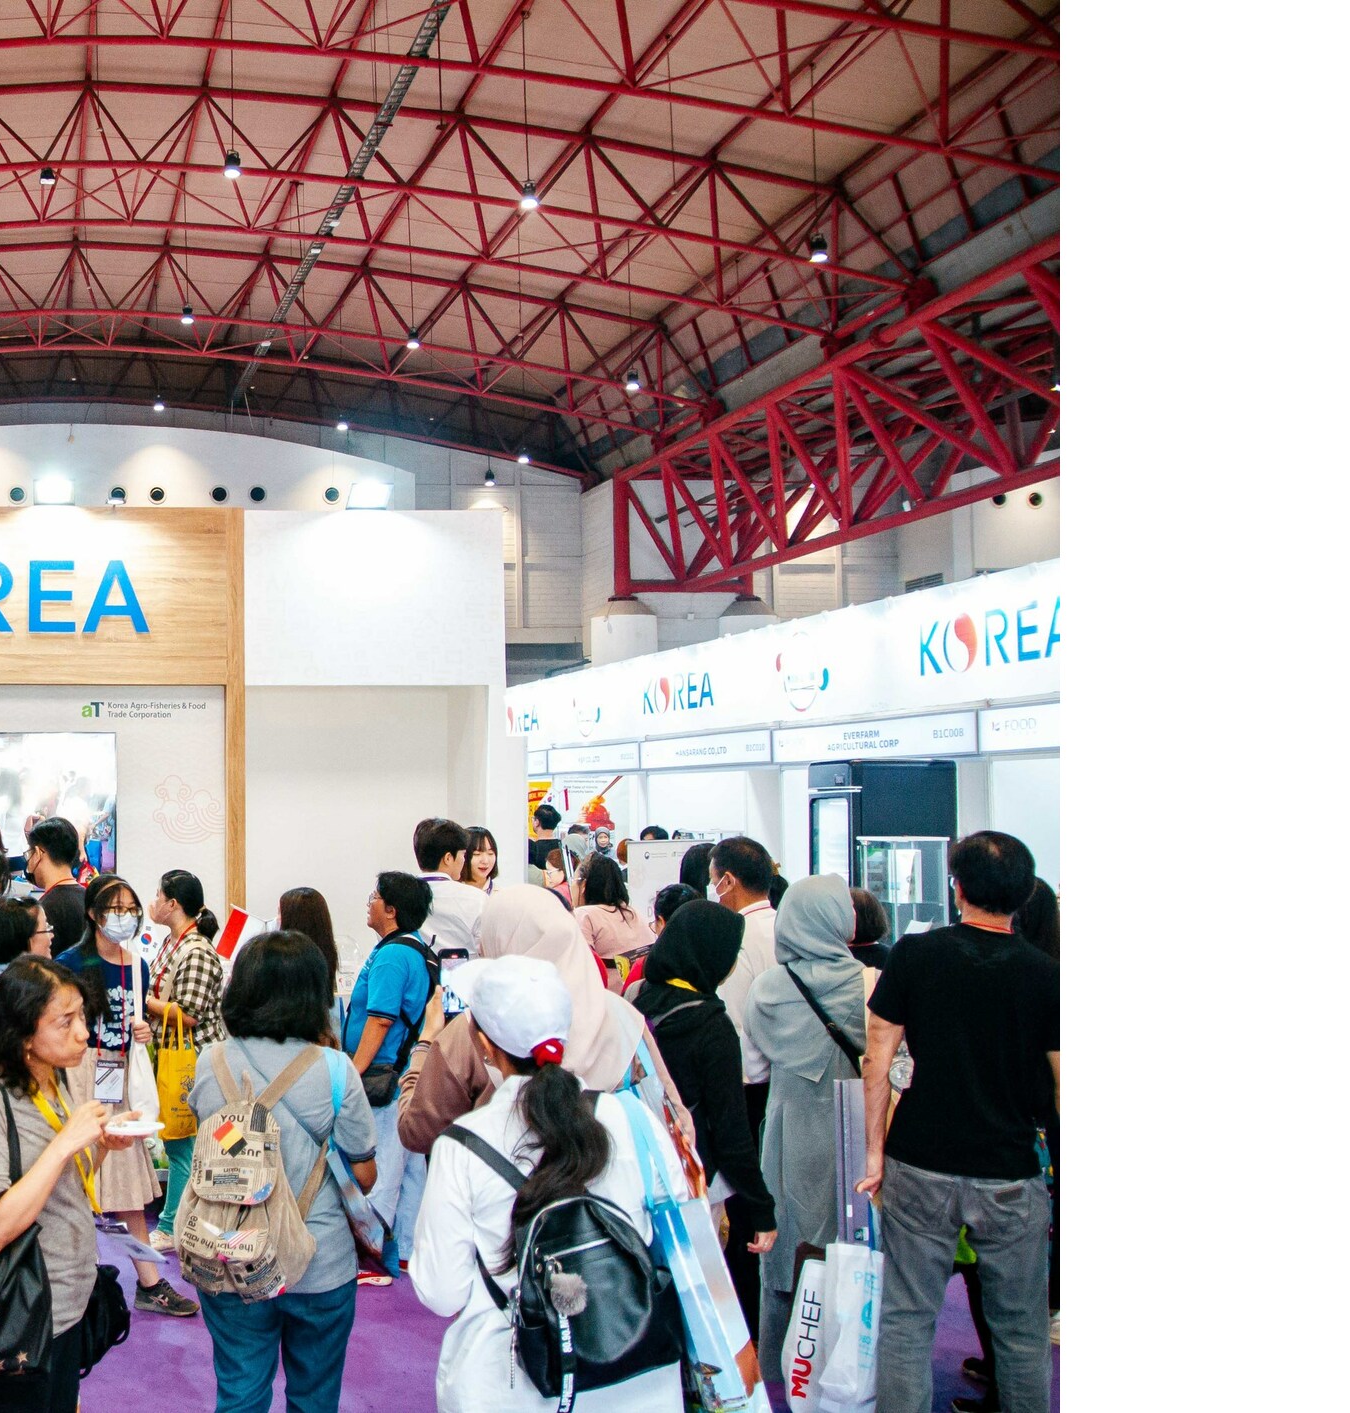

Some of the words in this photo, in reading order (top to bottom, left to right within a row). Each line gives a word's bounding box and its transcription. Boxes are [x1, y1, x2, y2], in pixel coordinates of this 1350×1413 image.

[643, 672, 714, 715] KOREA
[81, 701, 104, 718] aT
[107, 701, 129, 709] Korea
[130, 701, 181, 711] Agro-Fisheries
[188, 702, 206, 710] Food
[107, 710, 127, 718] Trade
[129, 710, 172, 720] Corporation
[843, 729, 880, 740] EVERFARM
[932, 728, 964, 739] B1C008
[827, 741, 877, 752] AGRICULTURAL
[878, 739, 900, 750] CORP
[791, 1288, 822, 1399] MUCHEF
